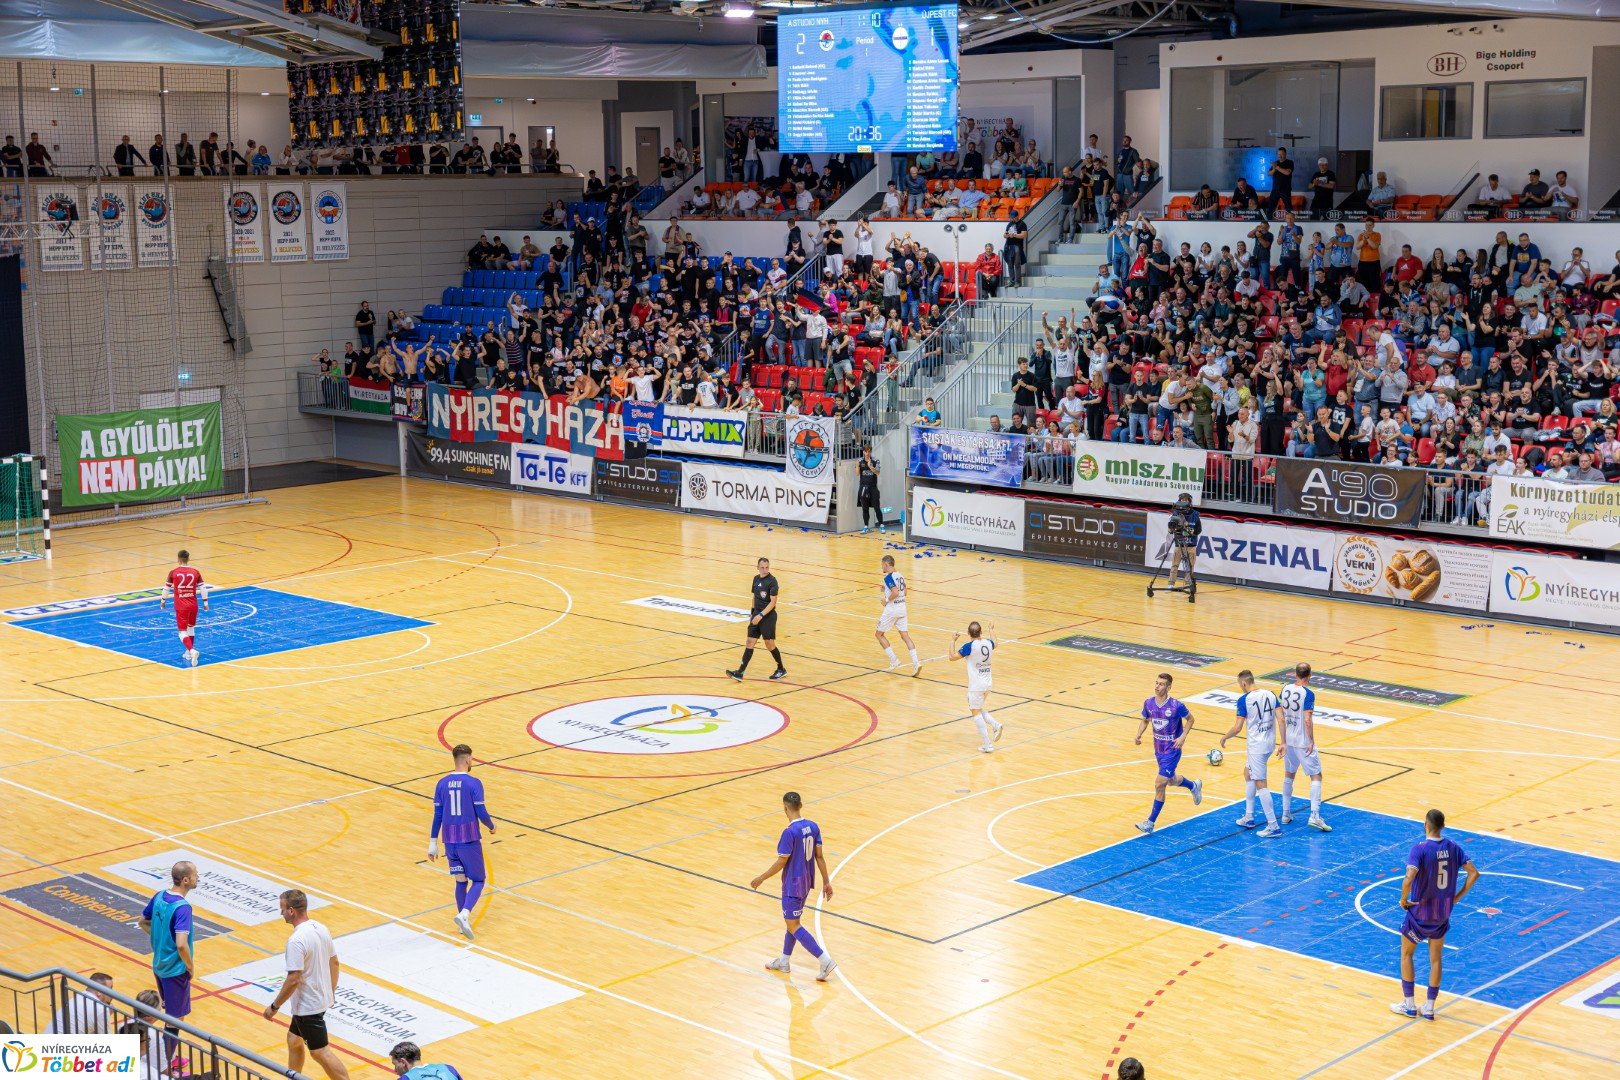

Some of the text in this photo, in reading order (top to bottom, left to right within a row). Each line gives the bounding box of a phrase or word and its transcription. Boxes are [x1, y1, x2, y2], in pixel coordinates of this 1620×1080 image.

[796, 33, 806, 54] 2
[1476, 49, 1537, 60] Bige Holding
[1486, 62, 1524, 71] Csoport
[848, 126, 882, 141] 20:36
[80, 418, 205, 459] A GYŰLÖLET
[922, 432, 955, 446] SZISZÁK
[430, 446, 450, 463] 99.4
[80, 455, 207, 495] NEM PÁLYA!
[516, 452, 587, 486] Ta-Te KFT
[1105, 459, 1204, 482] mlsz.hu
[1105, 475, 1130, 485] Magyar
[711, 480, 827, 508] TORMA PINCE
[1300, 495, 1398, 520] STUDIO
[1524, 507, 1530, 515] a
[1533, 506, 1598, 524] nyíregyházi
[947, 511, 1017, 531] NYÍREGYHÁZA
[1196, 534, 1328, 573] ARZENAL
[1345, 559, 1375, 571] VEKNI
[176, 573, 195, 589] 22
[980, 645, 990, 662] 9
[1252, 697, 1273, 720] 14
[1282, 689, 1301, 712] 33
[449, 790, 461, 816] 11
[803, 835, 814, 861] 10
[1437, 861, 1448, 889] 5
[43, 884, 142, 923] Continental
[334, 985, 417, 1023] YÍREGYHÁZI
